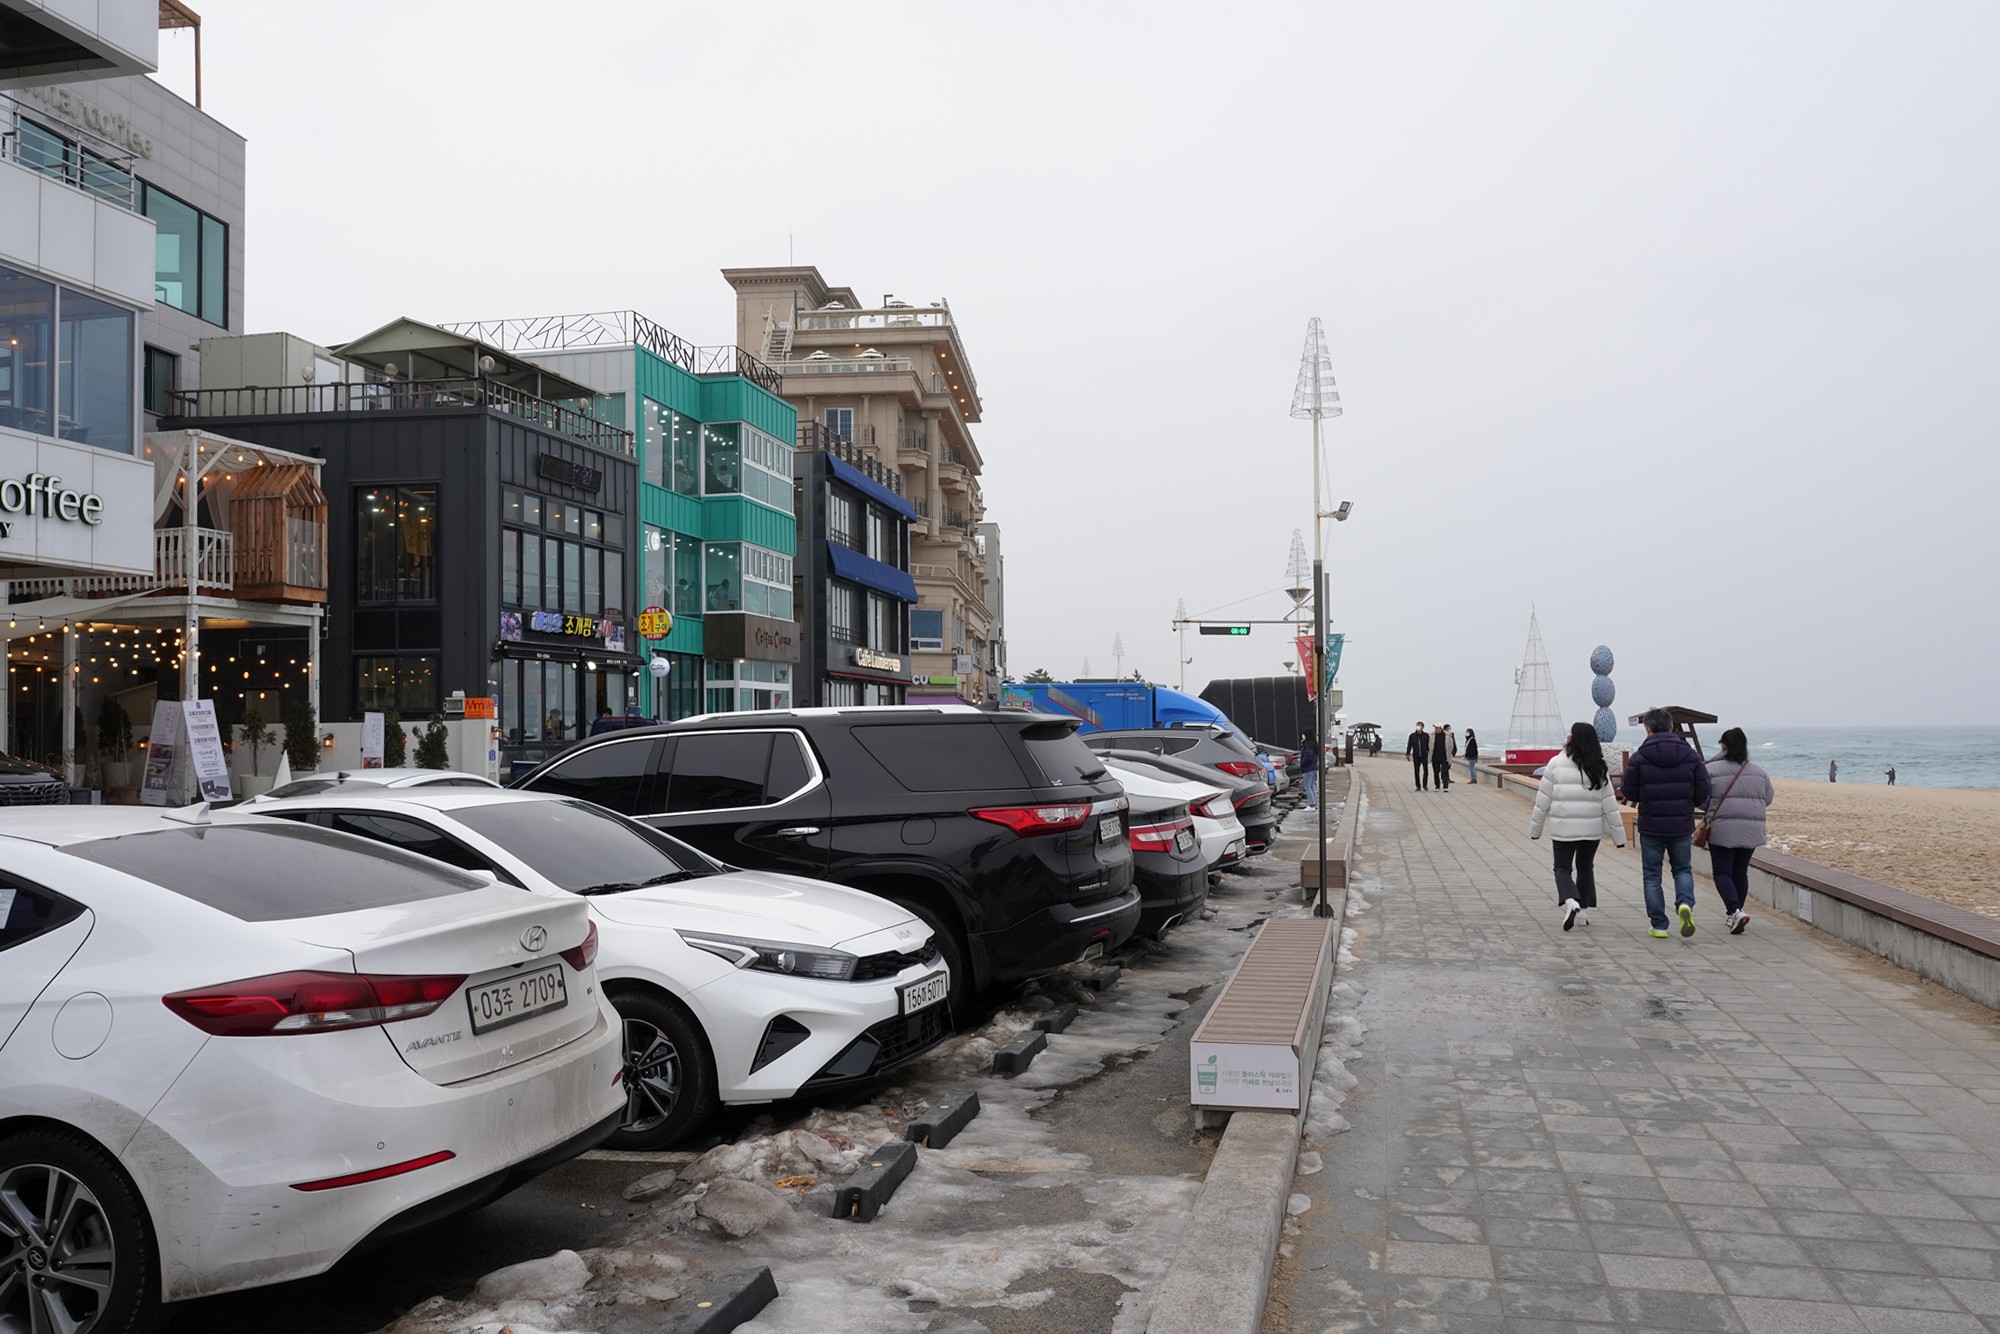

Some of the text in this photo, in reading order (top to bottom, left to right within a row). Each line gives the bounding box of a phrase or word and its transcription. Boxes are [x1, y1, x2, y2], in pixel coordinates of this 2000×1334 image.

[565, 616, 592, 637] 조개찜
[641, 614, 654, 632] 조개
[912, 675, 928, 685] CU
[480, 973, 556, 1020] 03주 2709
[405, 1030, 462, 1053] AVANTE
